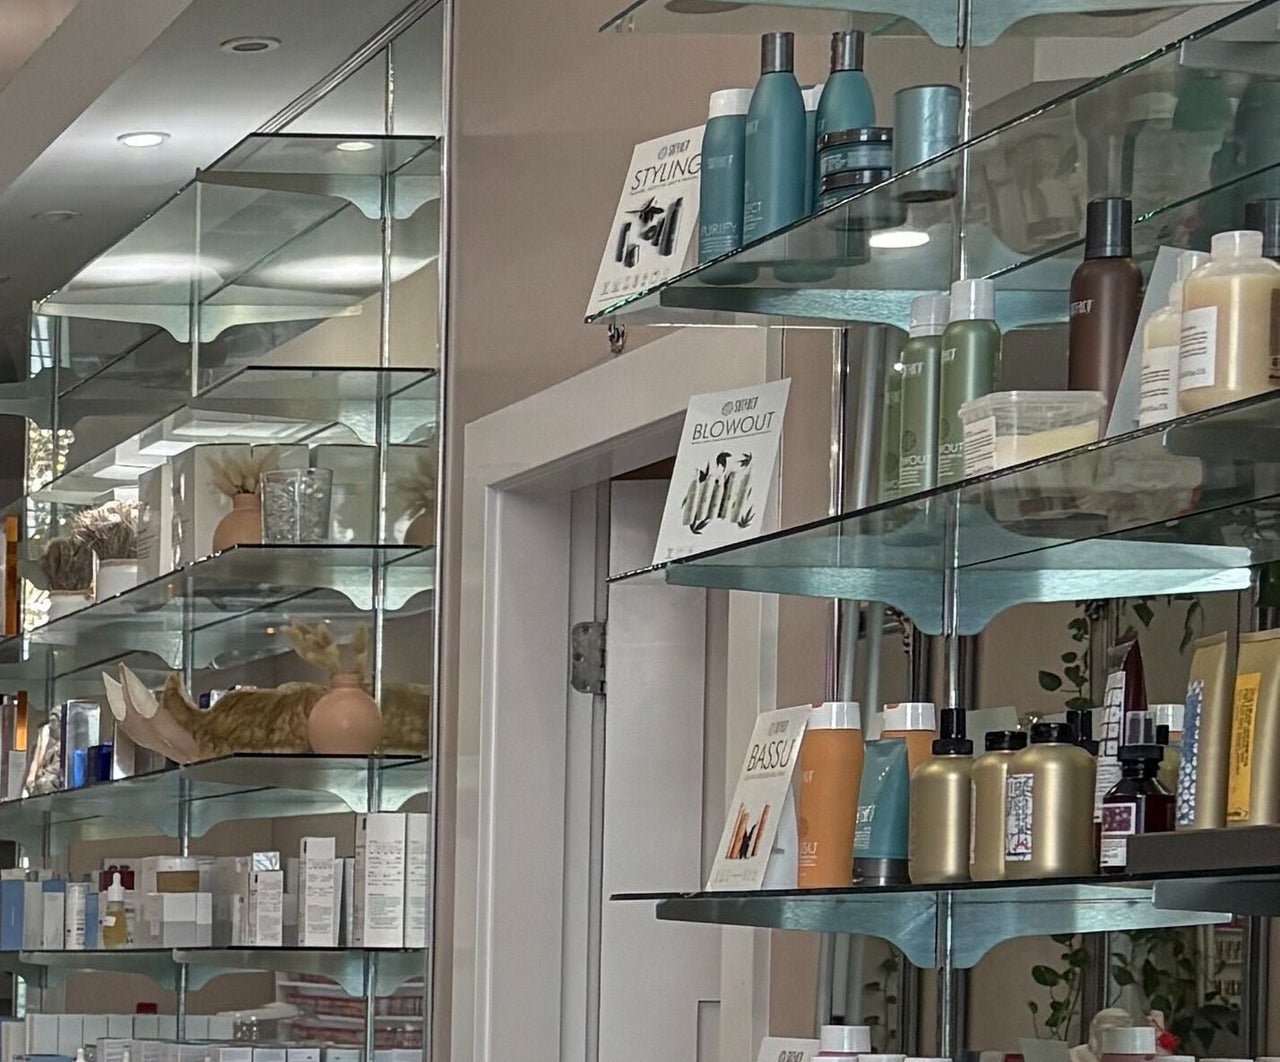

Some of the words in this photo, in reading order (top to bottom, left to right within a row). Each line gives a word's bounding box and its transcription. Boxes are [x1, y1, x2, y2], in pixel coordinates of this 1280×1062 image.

[631, 153, 701, 191] STYLING
[692, 411, 775, 441] BLOWOUT
[747, 738, 797, 772] BASSU
